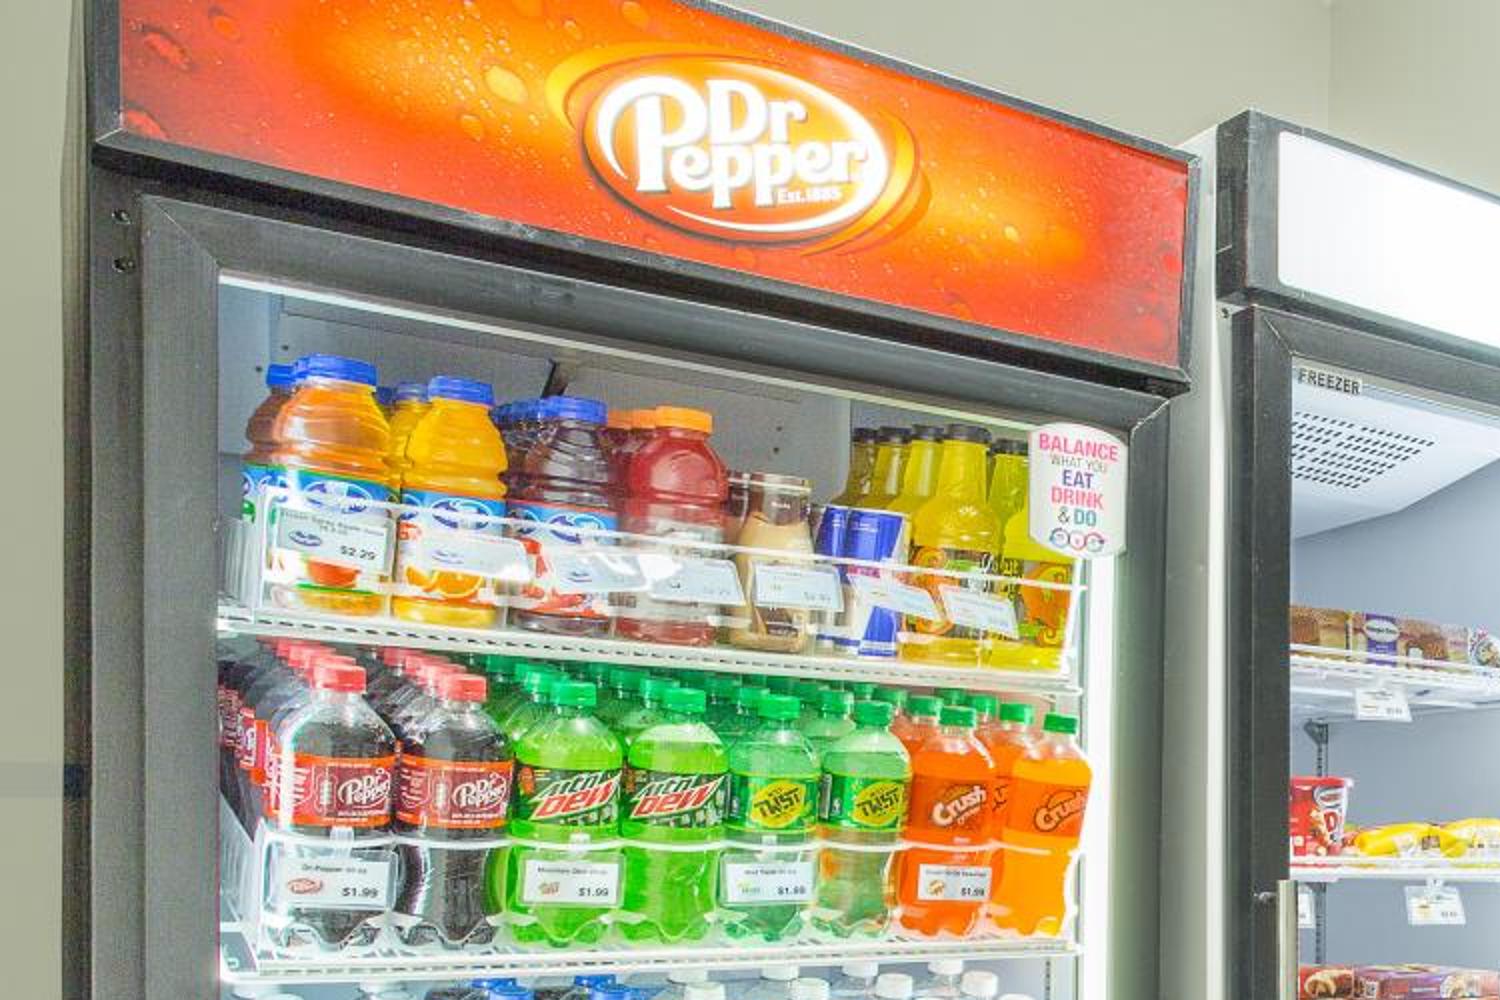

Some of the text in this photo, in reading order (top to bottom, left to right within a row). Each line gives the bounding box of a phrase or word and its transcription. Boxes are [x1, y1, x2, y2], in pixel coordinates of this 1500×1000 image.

[706, 79, 808, 144] Dr
[597, 75, 868, 209] Pepper
[1298, 368, 1361, 395] FREEZER
[1039, 432, 1118, 462] BALANCE
[1051, 454, 1107, 473] WHAT YOU
[1062, 469, 1094, 489] EAT
[1051, 486, 1104, 509] DRINK
[1057, 506, 1097, 527] & DO
[338, 775, 392, 806] Pepper
[453, 778, 506, 808] Pepper
[753, 787, 802, 818] TWIST
[855, 787, 900, 817] TWIST
[931, 785, 987, 827] Crush
[341, 887, 379, 899] $1.99
[578, 887, 610, 897] $1.99
